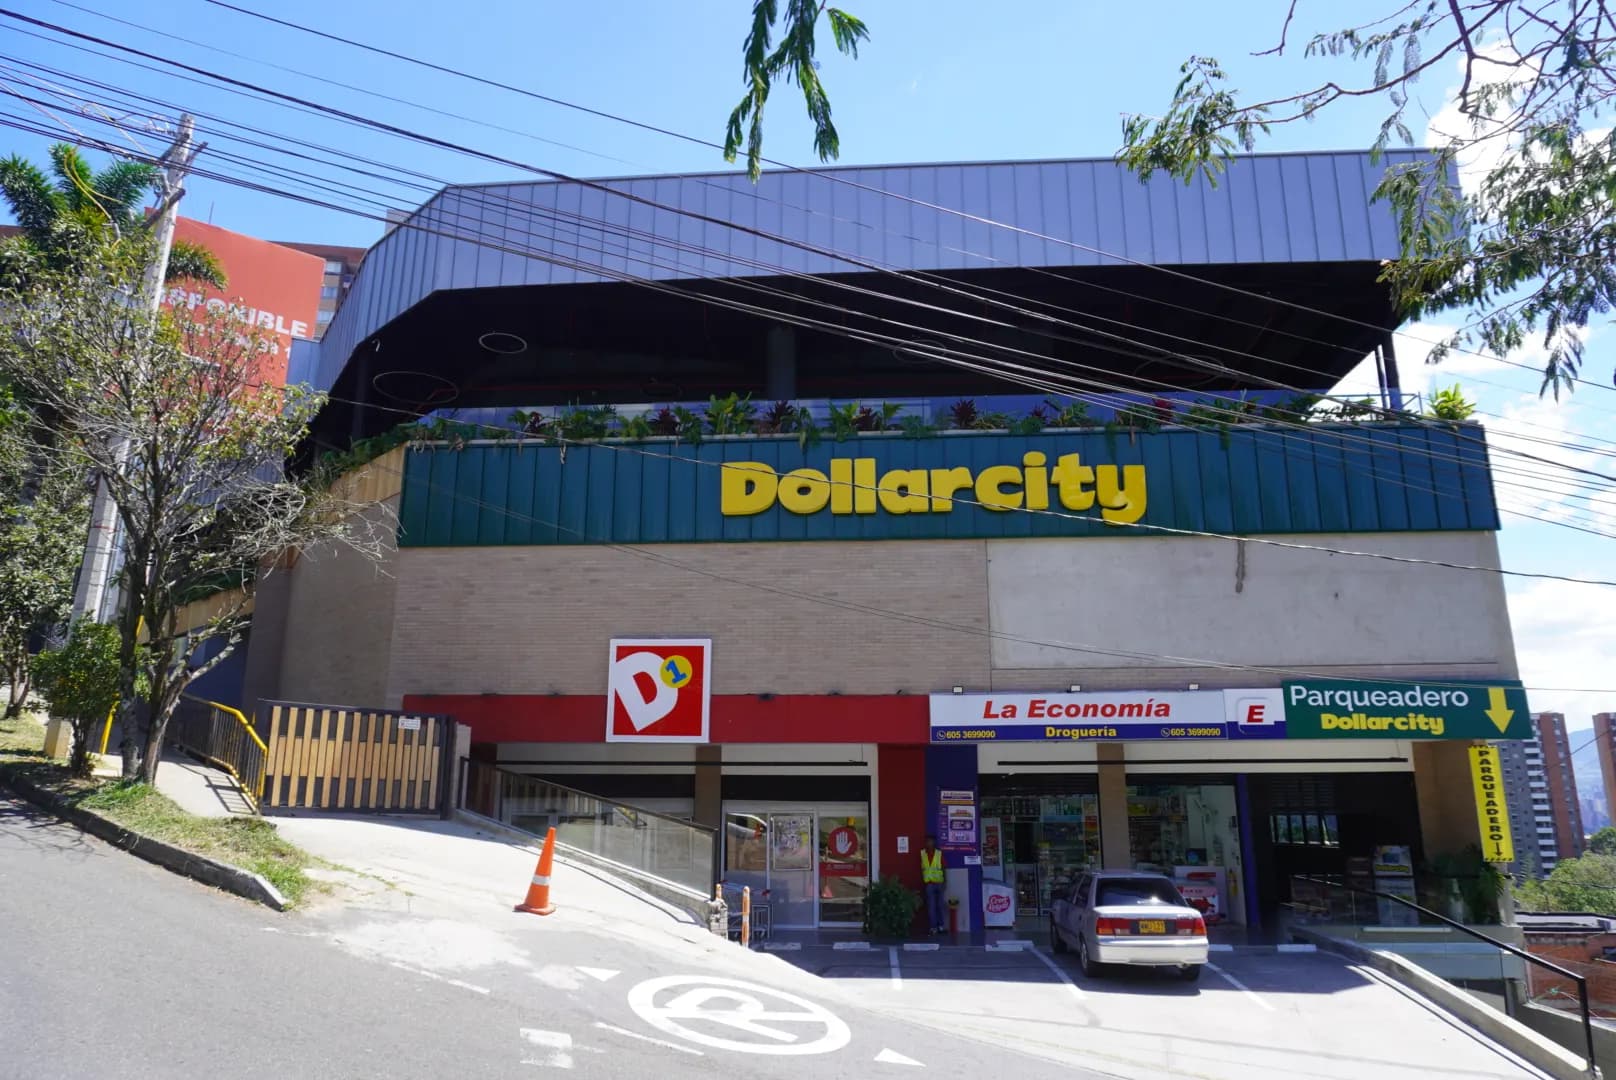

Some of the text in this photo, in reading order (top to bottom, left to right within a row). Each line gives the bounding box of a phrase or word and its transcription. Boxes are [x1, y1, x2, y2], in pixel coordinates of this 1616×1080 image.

[159, 286, 308, 338] ISPONIBLE
[720, 451, 1147, 526] Dollarcity
[983, 698, 1171, 719] La Economía
[1290, 685, 1469, 711] Parqueadero
[1246, 704, 1266, 723] E
[1320, 713, 1445, 736] Dollarcity
[946, 730, 996, 739] 605 3699090
[1045, 726, 1117, 739] Droguería
[1170, 728, 1221, 737] 605 3699090
[1477, 749, 1504, 841] PARQUEADERO
